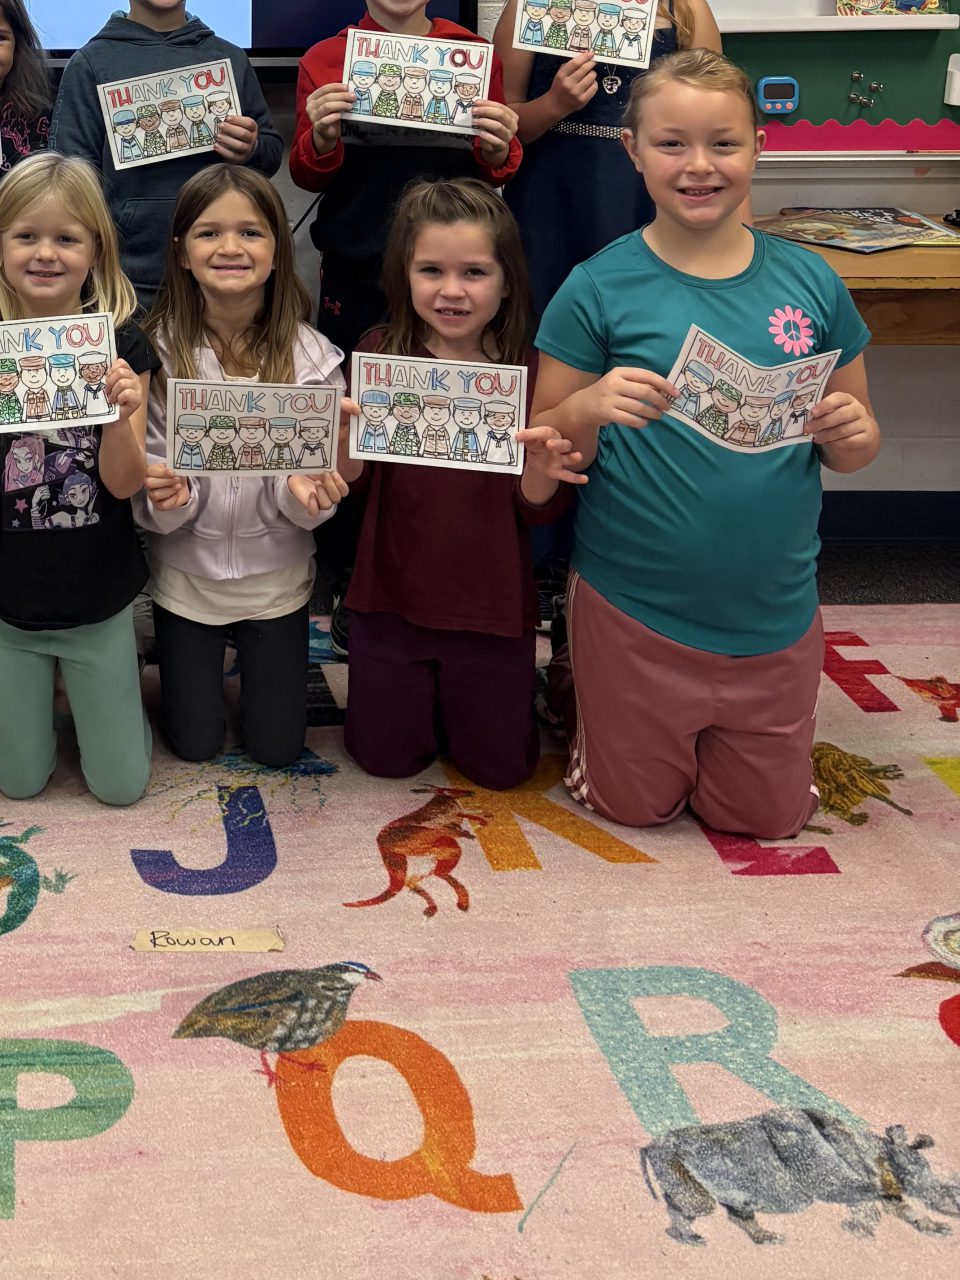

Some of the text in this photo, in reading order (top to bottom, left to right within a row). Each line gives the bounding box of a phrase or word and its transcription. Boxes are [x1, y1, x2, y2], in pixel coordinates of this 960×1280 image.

[357, 37, 484, 70] THANK YOU
[107, 67, 226, 108] THANK YOU
[48, 323, 105, 350] YOU
[363, 362, 517, 396] THANK YOU
[697, 338, 832, 394] THANK YOU
[179, 388, 331, 415] THANK YOU
[150, 930, 235, 948] Rowan
[276, 1019, 524, 1214] Q
